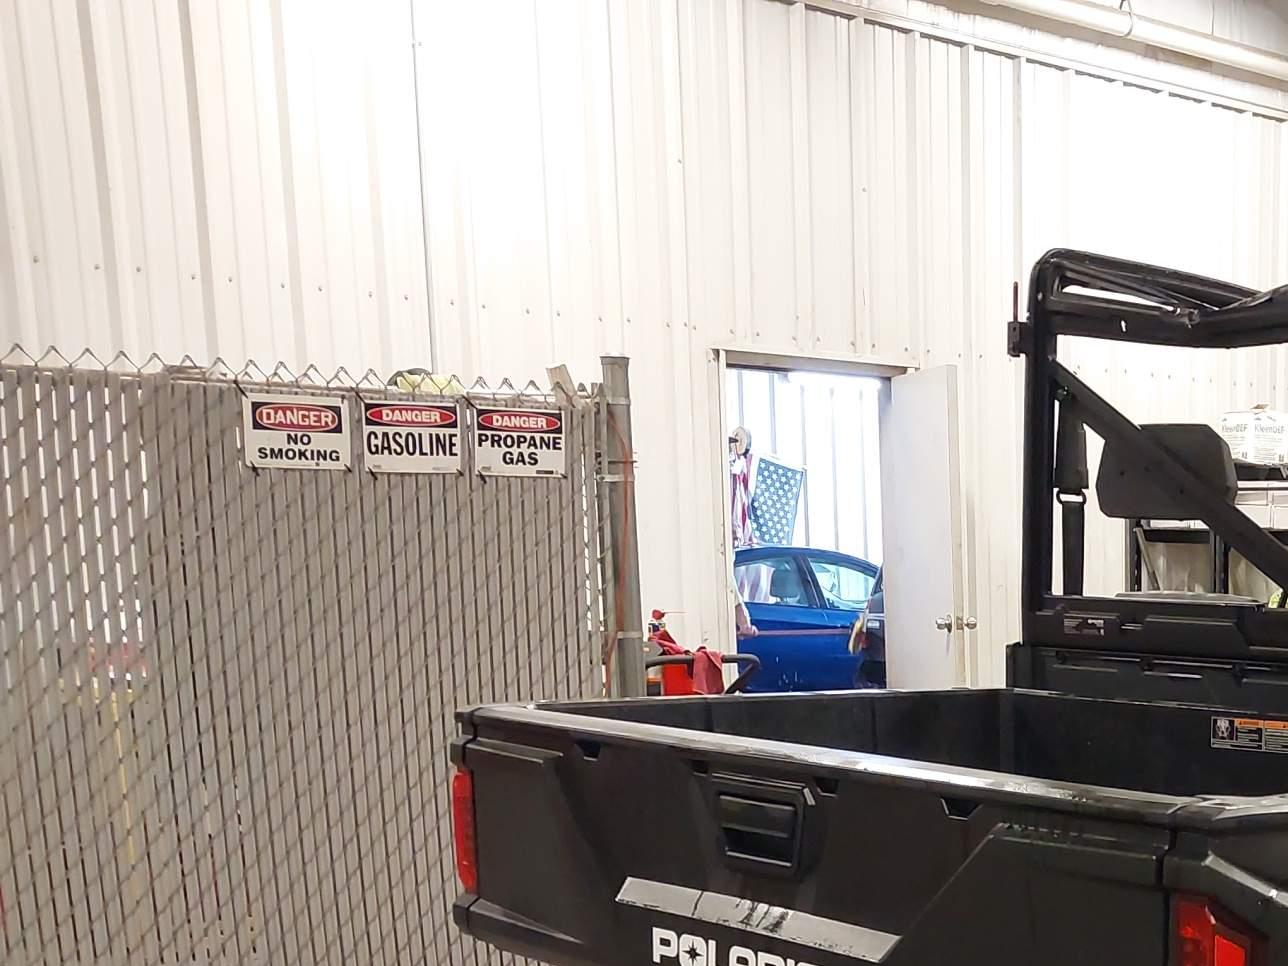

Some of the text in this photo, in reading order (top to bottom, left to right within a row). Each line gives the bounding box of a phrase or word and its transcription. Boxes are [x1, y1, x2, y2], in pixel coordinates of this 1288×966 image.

[262, 408, 333, 427] DANGER
[382, 408, 441, 424] DANGER
[492, 414, 547, 429] DANGER
[286, 433, 311, 446] NO
[366, 431, 458, 458] GASOLINE
[477, 433, 562, 451] PROPANE
[257, 447, 340, 462] SMOKING
[502, 452, 539, 466] GAS
